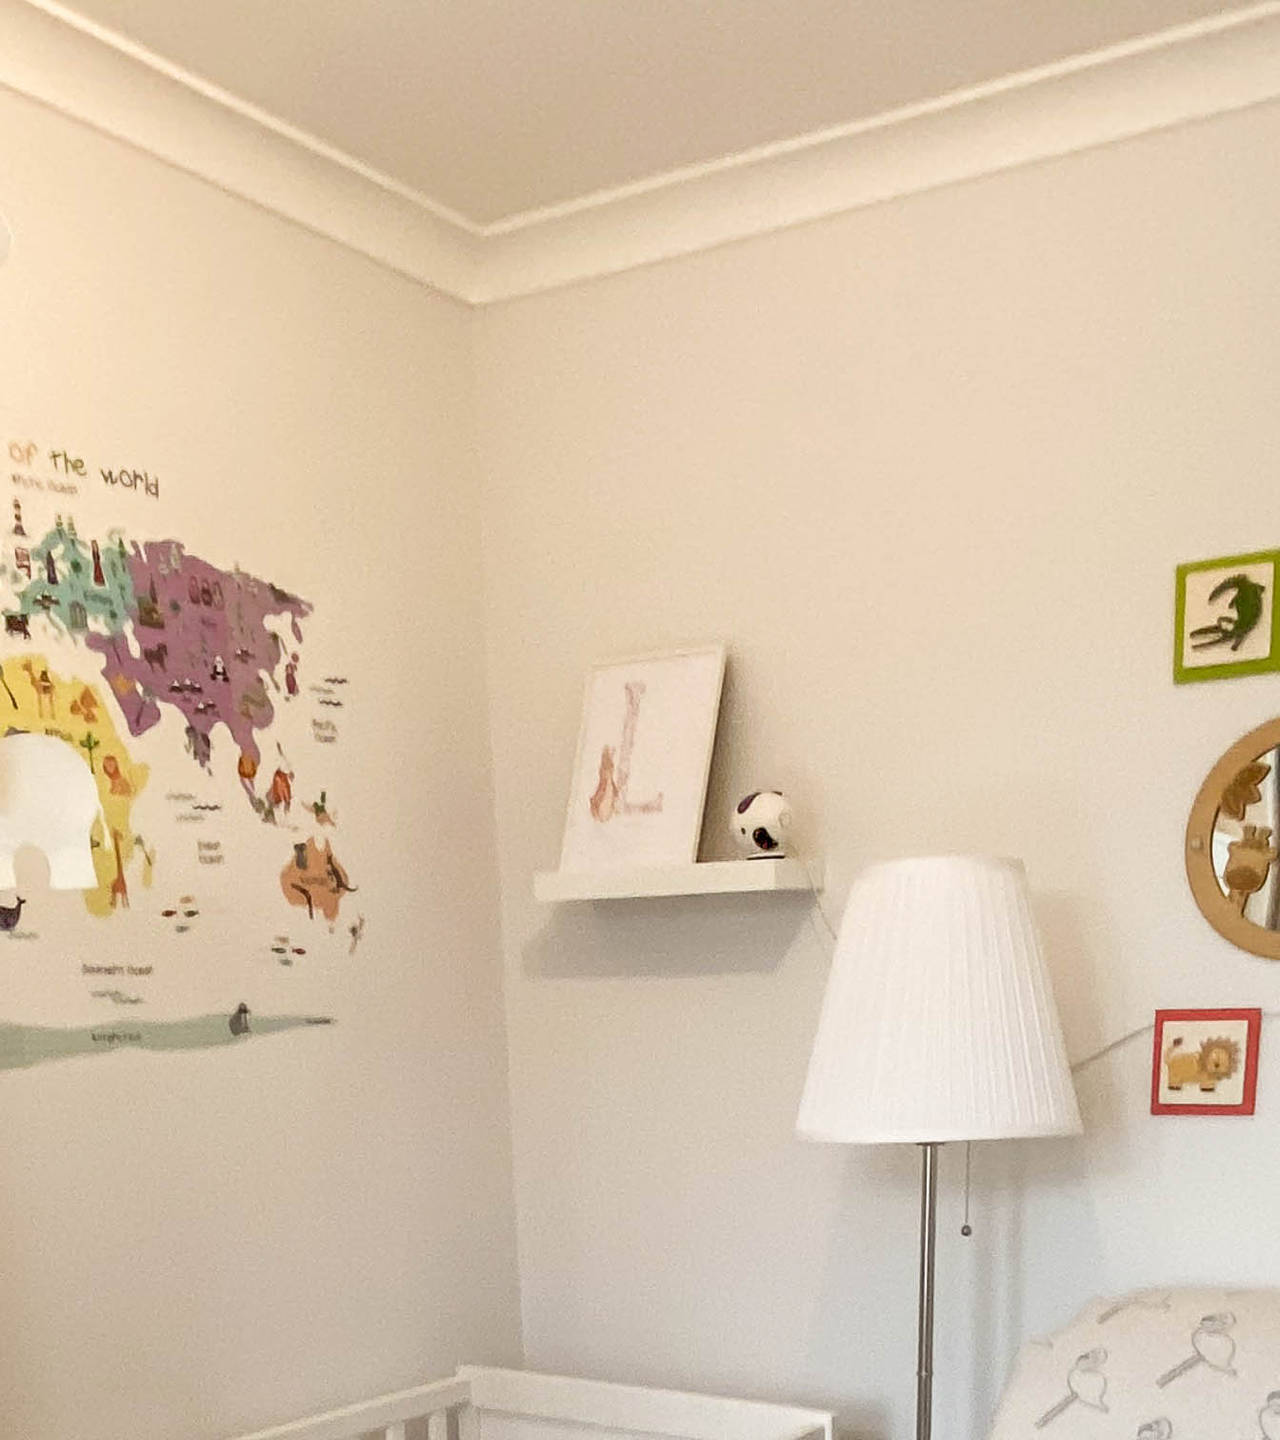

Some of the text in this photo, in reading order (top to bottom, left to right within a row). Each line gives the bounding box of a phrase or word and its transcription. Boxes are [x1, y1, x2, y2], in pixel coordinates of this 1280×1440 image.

[8, 440, 38, 465] of
[49, 449, 87, 477] the
[101, 468, 159, 499] world
